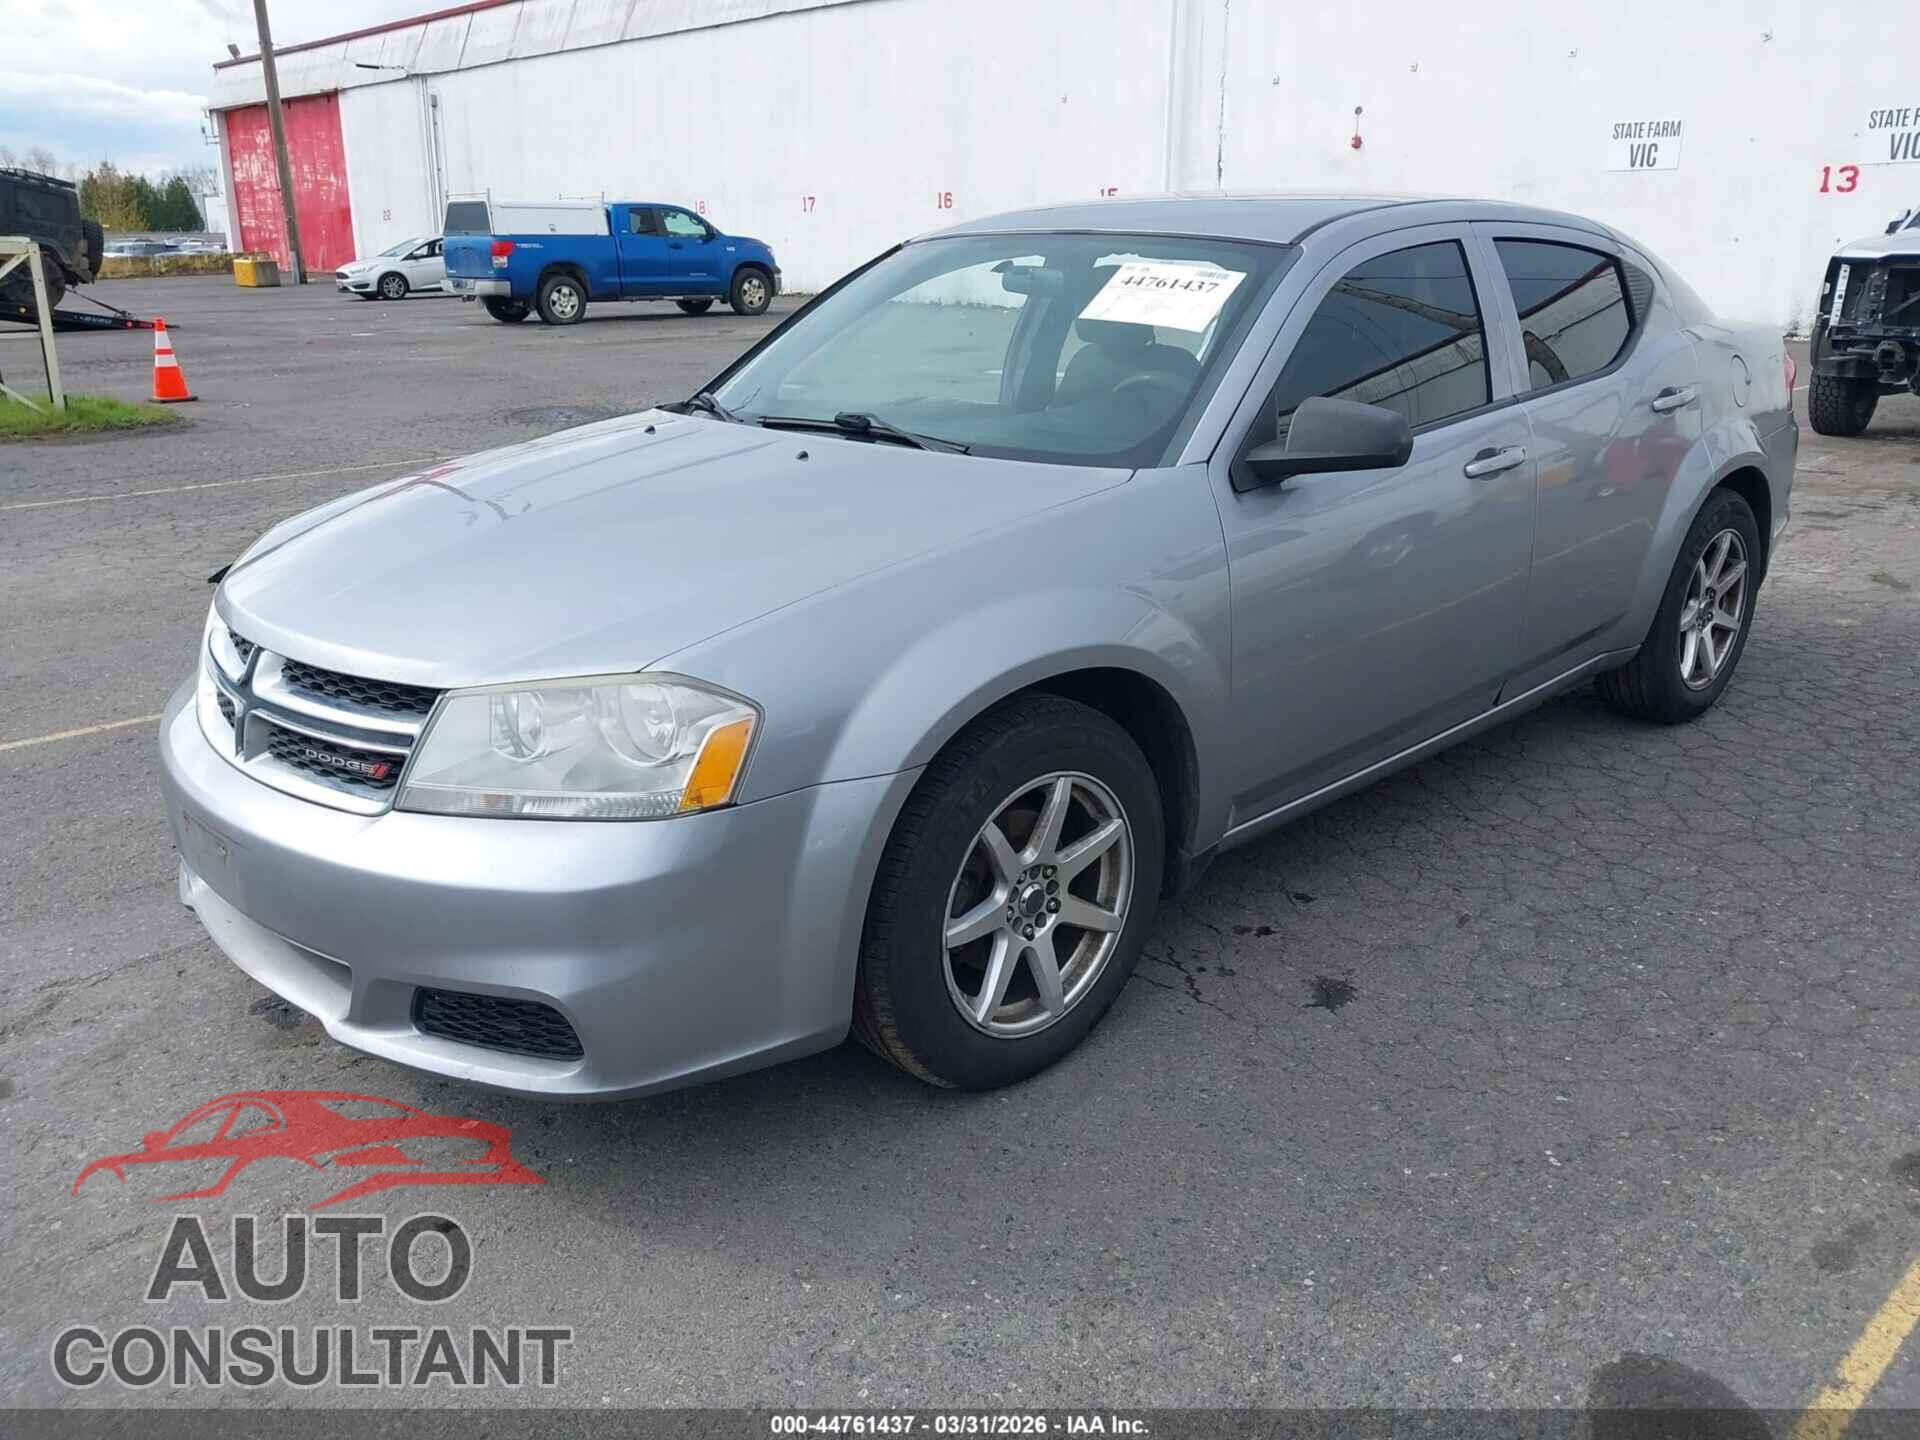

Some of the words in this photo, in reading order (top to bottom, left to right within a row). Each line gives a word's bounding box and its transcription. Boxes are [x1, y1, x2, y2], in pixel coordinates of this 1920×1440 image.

[1869, 108, 1911, 129] STATE
[1612, 121, 1646, 140] STATE
[1647, 119, 1682, 138] FARM
[1630, 143, 1658, 168] VIC
[1820, 165, 1859, 192] 13
[802, 196, 816, 213] 17
[938, 191, 953, 209] 16
[1121, 275, 1220, 294] 44761437
[305, 748, 376, 776] DODGE
